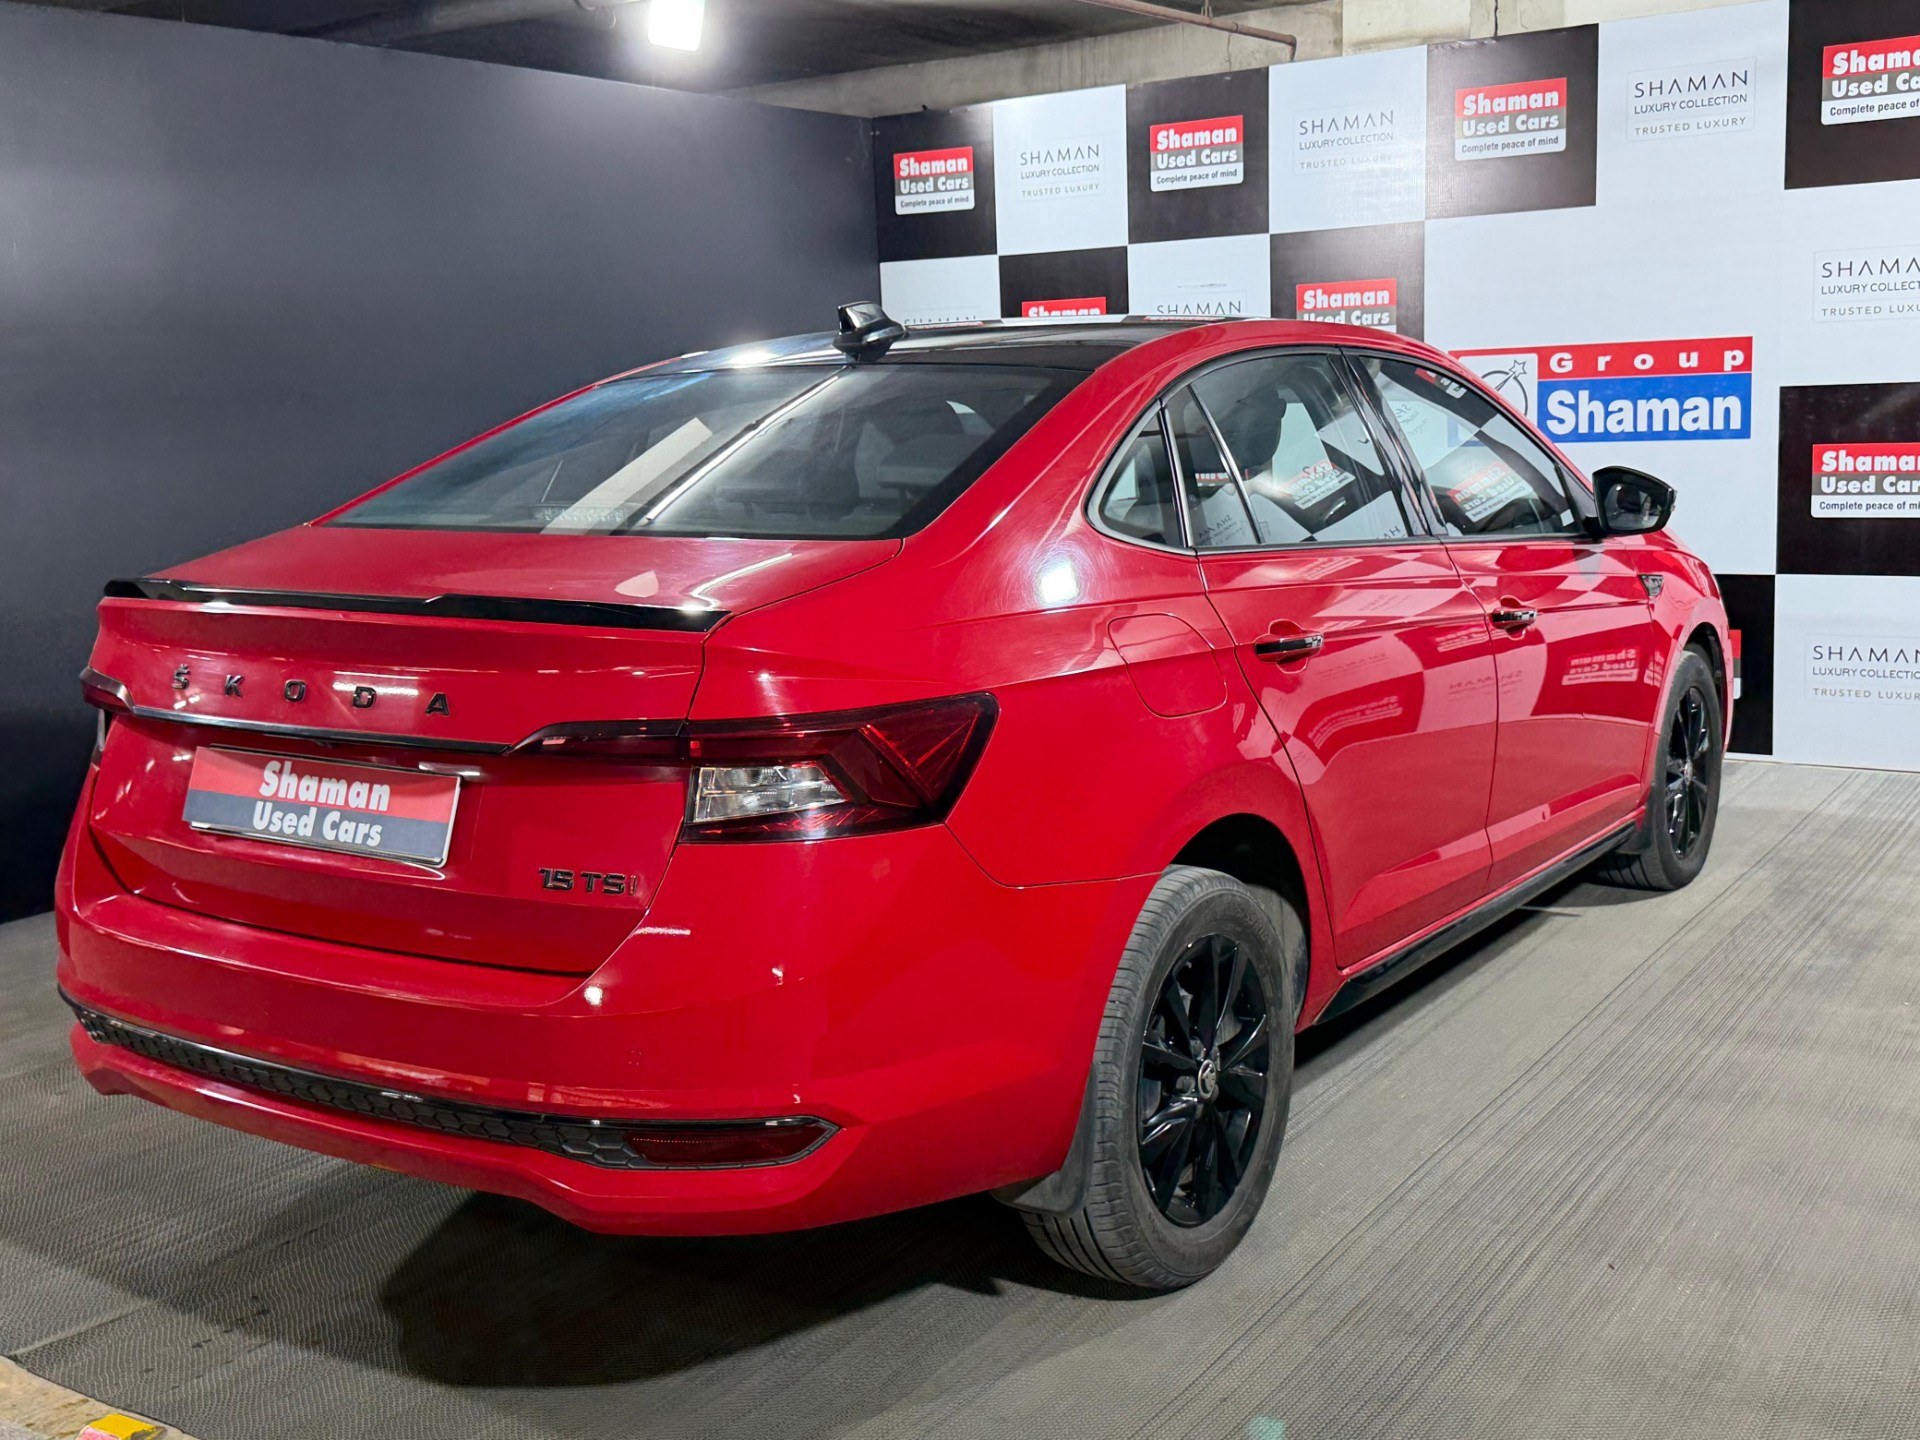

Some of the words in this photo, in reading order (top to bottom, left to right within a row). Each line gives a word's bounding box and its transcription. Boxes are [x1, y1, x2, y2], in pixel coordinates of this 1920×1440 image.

[1634, 70, 1748, 98] SHAMAN
[1831, 74, 1889, 98] Used
[1462, 88, 1559, 116] Shaman
[1634, 101, 1677, 115] LUXURY
[1679, 93, 1748, 110] COLLECTION
[1829, 104, 1875, 116] Complete
[1877, 100, 1907, 113] peace
[1909, 98, 1920, 108] of
[1299, 110, 1394, 135] SHAMAN
[1462, 115, 1509, 137] Used
[1515, 112, 1559, 133] Cars
[1634, 123, 1690, 136] TRUSTED
[1696, 116, 1747, 130] LUXURY
[1156, 126, 1237, 150] Shaman
[1299, 138, 1335, 151] LUXURY
[1336, 131, 1394, 147] COLLECTION
[1461, 141, 1499, 154] Complete
[1501, 138, 1526, 151] peace
[1527, 137, 1536, 147] of
[1537, 135, 1559, 146] mind
[1020, 144, 1100, 166] SHAMAN
[1156, 150, 1199, 169] Used
[1201, 146, 1238, 164] Cars
[1300, 157, 1346, 170] TRUSTED
[899, 157, 968, 177] Shaman
[1020, 169, 1051, 180] LUXURY
[1052, 164, 1100, 177] COLLECTION
[1156, 174, 1188, 185] Complete
[1189, 172, 1210, 183] peace
[1211, 170, 1219, 179] of
[1220, 169, 1237, 178] mind
[899, 177, 933, 195] Used
[937, 175, 969, 192] Cars
[1021, 186, 1061, 198] TRUSTED
[1065, 183, 1100, 194] LUXURY
[900, 199, 927, 209] Complete
[928, 197, 946, 208] peace
[947, 196, 954, 205] of
[954, 195, 969, 204] mind
[1821, 283, 1868, 295] LUXURY
[1156, 300, 1242, 315] SHAMAN
[1302, 289, 1390, 310] Shaman
[1349, 309, 1390, 327] Cars
[1821, 305, 1882, 317] TRUSTED
[1549, 349, 1745, 373] Group
[1546, 389, 1742, 435] Shaman
[1820, 449, 1920, 473] Shama
[1820, 475, 1876, 494] Used
[1819, 500, 1863, 512] Complete
[1865, 501, 1894, 512] peace
[1896, 501, 1906, 510] of
[1812, 666, 1858, 677] LUXURY
[1812, 687, 1872, 698] TRUSTED
[258, 760, 391, 812] Shaman
[252, 800, 318, 838] Used
[322, 810, 383, 848] Cars
[580, 871, 638, 896] TSI
